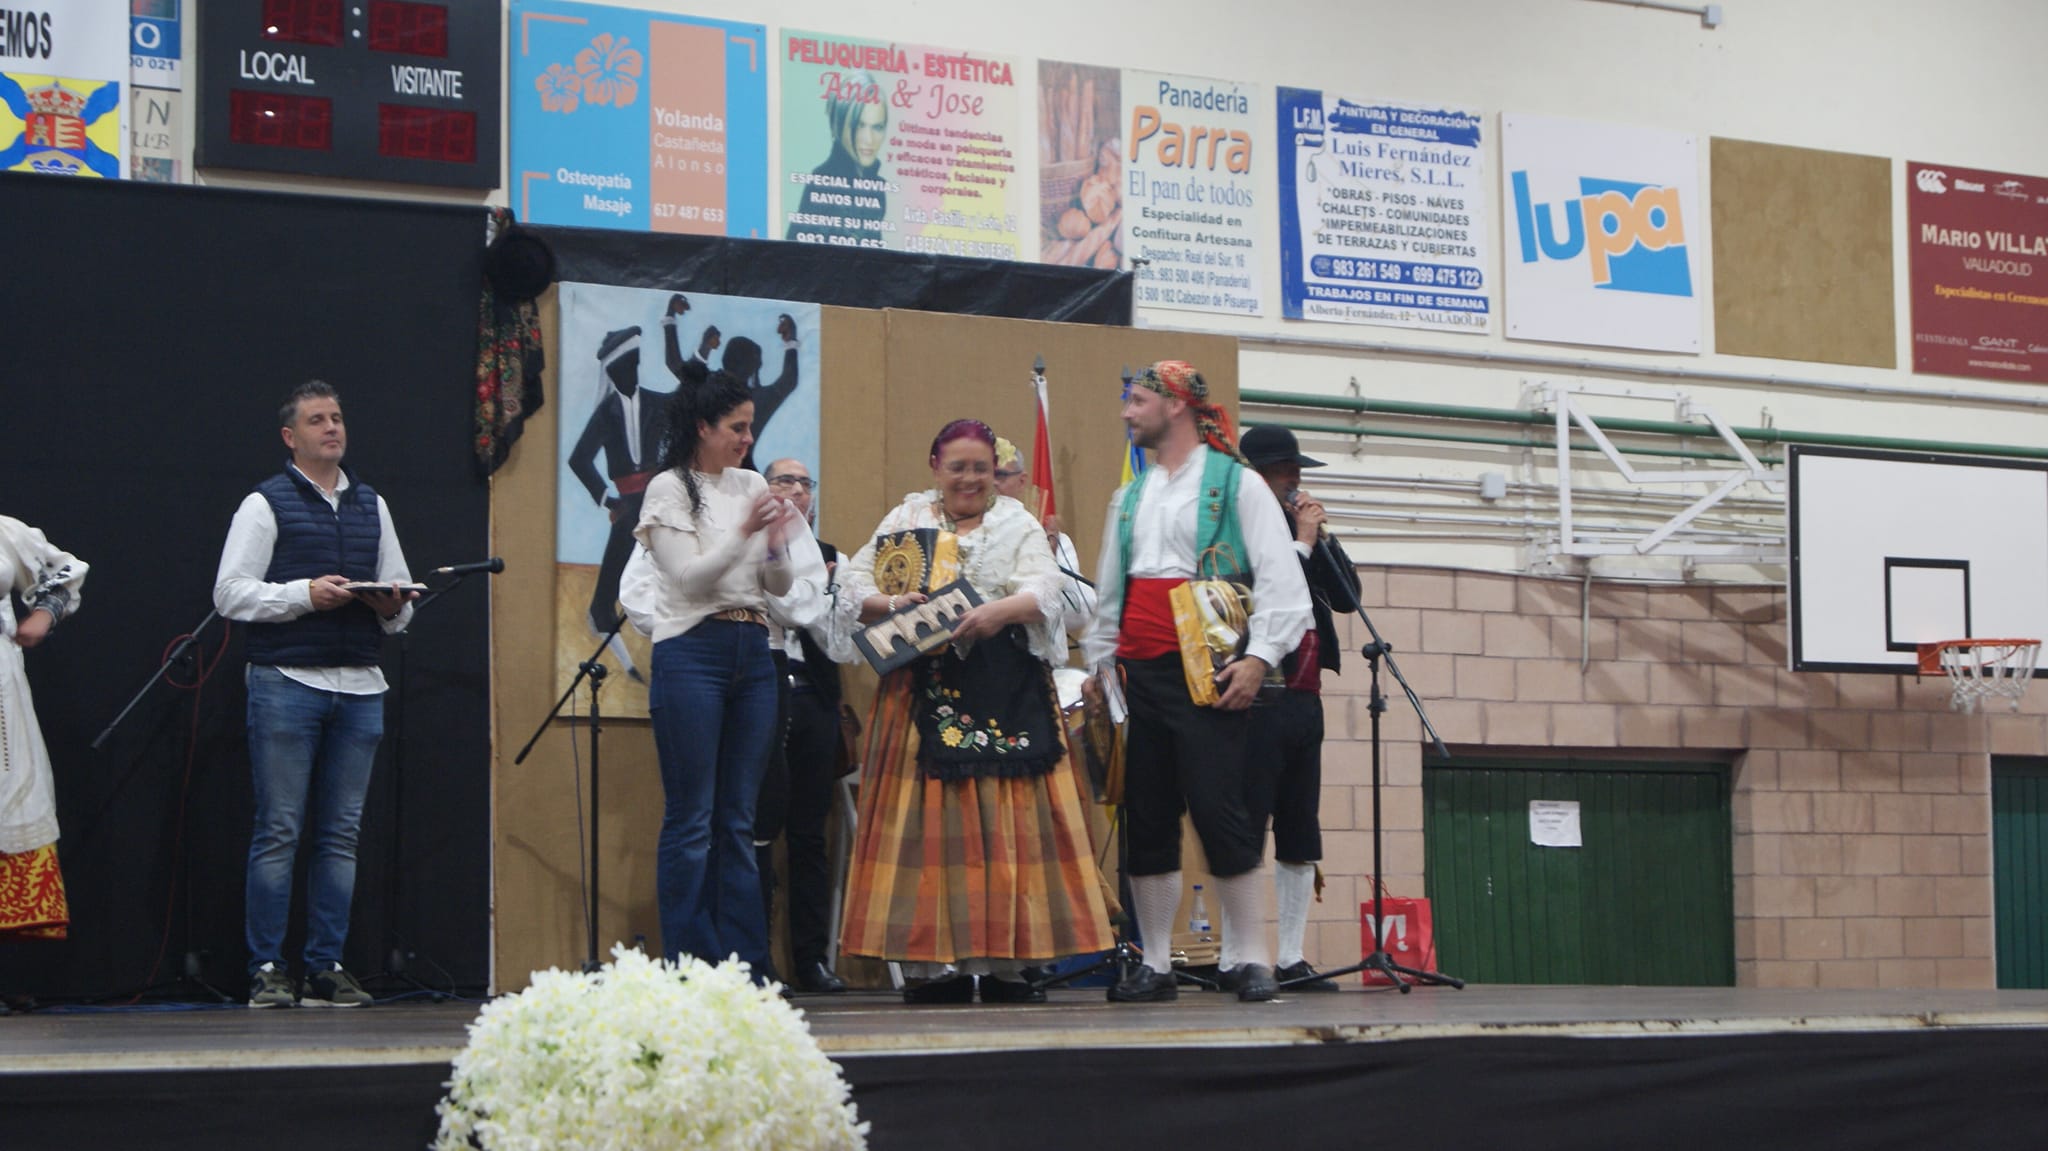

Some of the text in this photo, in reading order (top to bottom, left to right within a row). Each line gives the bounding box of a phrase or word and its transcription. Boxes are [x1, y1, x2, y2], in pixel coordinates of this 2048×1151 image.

[149, 57, 174, 71] 021
[240, 50, 315, 84] LOCAL
[788, 37, 909, 74] PELUQUERÍA
[924, 52, 1014, 86] ESTÉTICA
[391, 65, 463, 99] VISITANTE
[820, 72, 985, 119] Ana & Jose
[1158, 80, 1248, 114] Panadería
[654, 106, 723, 132] Yolanda
[1390, 111, 1399, 121] Y
[944, 127, 1003, 142] tendencias
[1129, 105, 1253, 175] Parra
[1371, 123, 1440, 140] EN GENERAL
[654, 133, 723, 153] Castañeda
[889, 136, 903, 147] de
[906, 139, 936, 150] moda
[940, 143, 953, 152] en
[1332, 138, 1471, 167] Luis Fernández
[887, 151, 1015, 173] y eficaces tratamientos
[790, 172, 900, 193] ESPECIAL NOVIAS
[954, 170, 997, 185] faciales
[1411, 168, 1465, 188] S.L.L.
[1129, 170, 1254, 207] El pan de todos
[583, 194, 632, 217] Masaje
[810, 192, 881, 208] RAYOS UVA
[1383, 193, 1416, 206] PISOS
[654, 203, 724, 223] 617 487 653
[787, 213, 897, 232] RESERVE SU HORA
[1142, 207, 1243, 227] Especialidad en
[1386, 208, 1470, 226] COMUNIDADES
[1132, 226, 1253, 248] Confitura Artesana
[1511, 170, 1685, 283] lupa
[1317, 233, 1477, 257] DE TERRAZAS Y CUBIERTAS
[1921, 223, 2048, 257] MARIO VILLA
[1333, 258, 1480, 287] 983 261 549 699 475 122
[1962, 256, 2031, 277] VALLADOLID
[1307, 286, 1486, 310] TRABAJOS EN FIN DE SEMANA
[1978, 336, 2018, 348] GANT
